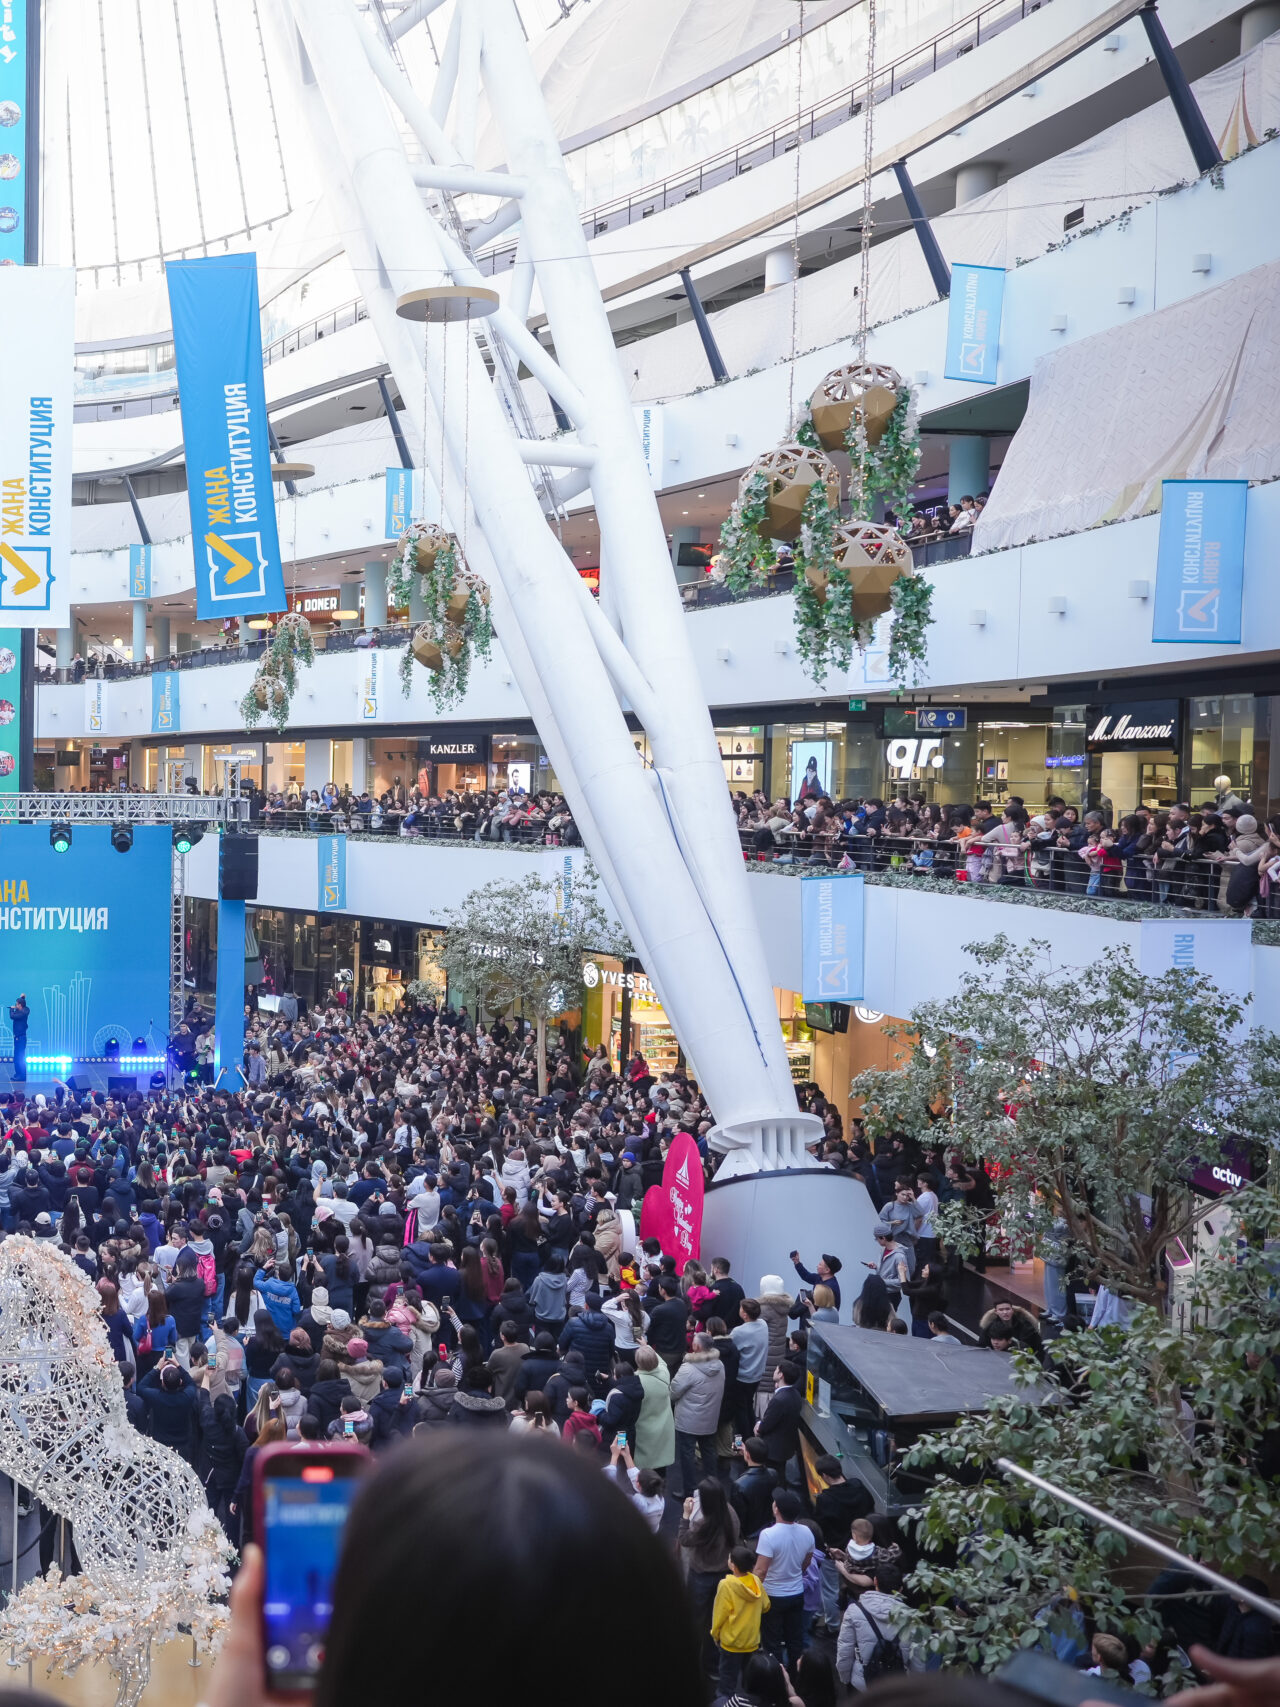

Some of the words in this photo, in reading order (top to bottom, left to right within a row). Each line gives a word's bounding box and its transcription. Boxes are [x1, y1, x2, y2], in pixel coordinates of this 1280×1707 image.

[29, 396, 56, 537] КОНСТИТУЦИЯ
[223, 382, 258, 523] КОНСТИТУЦИЯ
[1, 477, 27, 537] ЖАҢА
[205, 465, 231, 526] ЖАҢА
[304, 597, 338, 612] DONER
[429, 743, 476, 756] KANZLER
[331, 838, 339, 883] КОНСТИТУЦИЯ
[601, 970, 635, 989] YVES
[1212, 1166, 1242, 1187] activ
